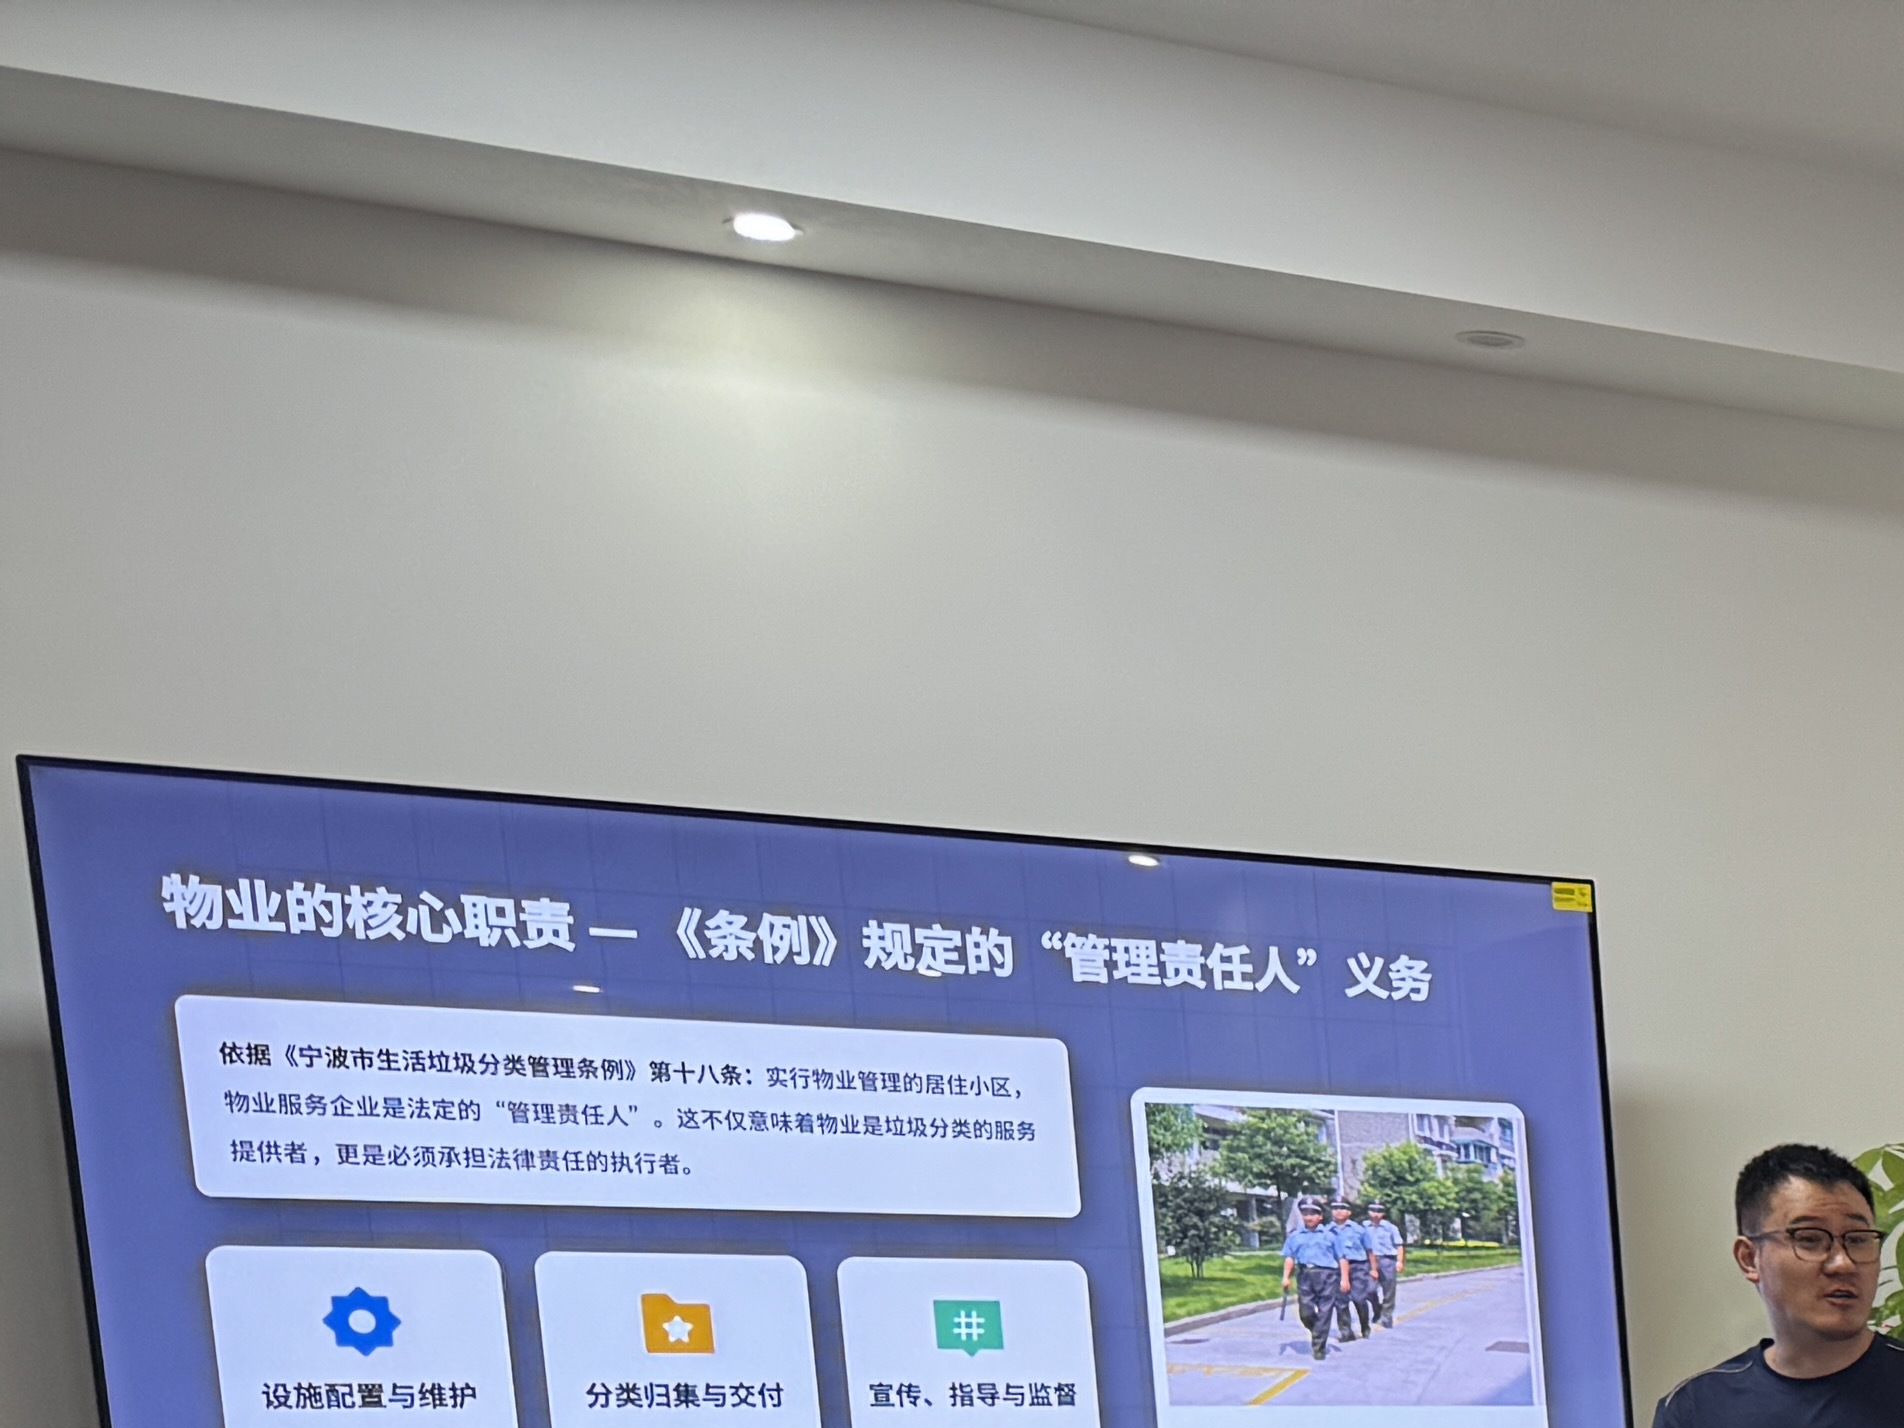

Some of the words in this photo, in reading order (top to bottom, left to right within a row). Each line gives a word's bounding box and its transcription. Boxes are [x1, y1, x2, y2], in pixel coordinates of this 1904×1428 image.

[231, 1139, 696, 1177] 提供者，更是必须承担法律责任的执行者。
[262, 1382, 478, 1411] 设施配置与维护
[585, 1382, 784, 1410] 分类归集与交付
[868, 1382, 1078, 1410] 宣传、指导与监督
